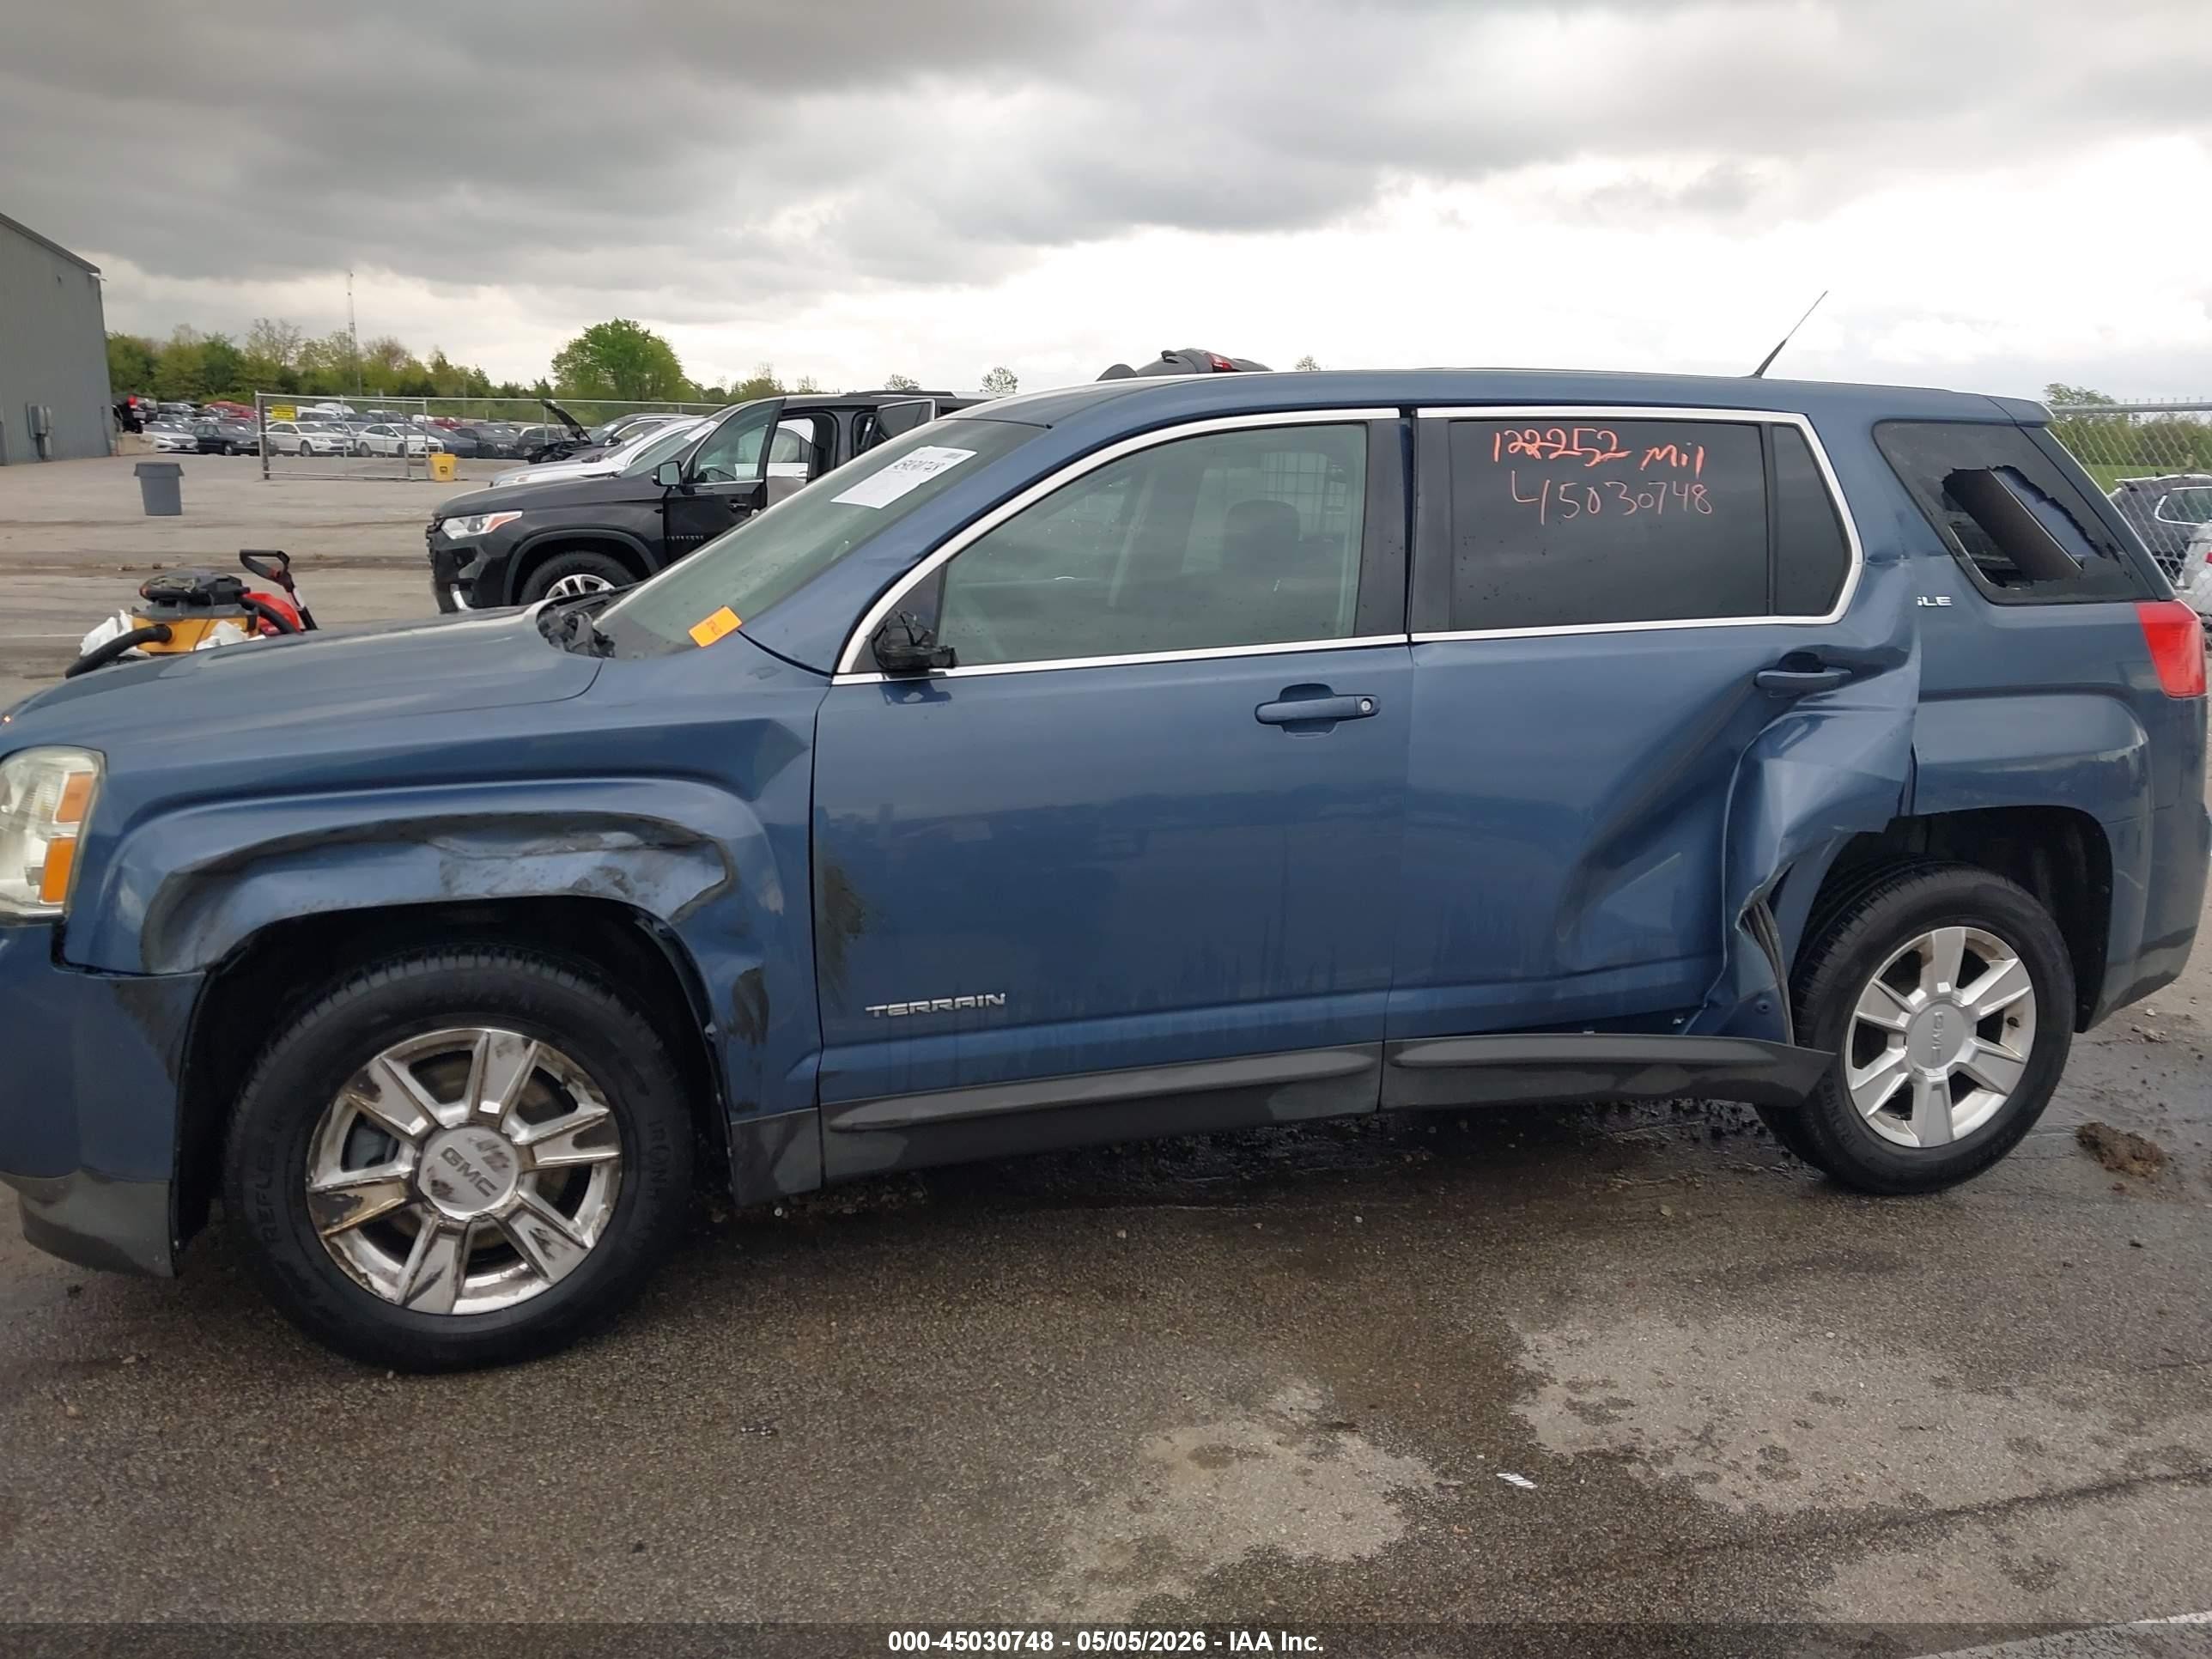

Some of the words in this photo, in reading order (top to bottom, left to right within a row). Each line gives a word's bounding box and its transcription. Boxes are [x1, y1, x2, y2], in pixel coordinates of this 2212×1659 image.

[1511, 470, 1713, 526] 45030748
[865, 992, 1006, 1018] TERRAIN
[441, 1146, 498, 1198] GMC
